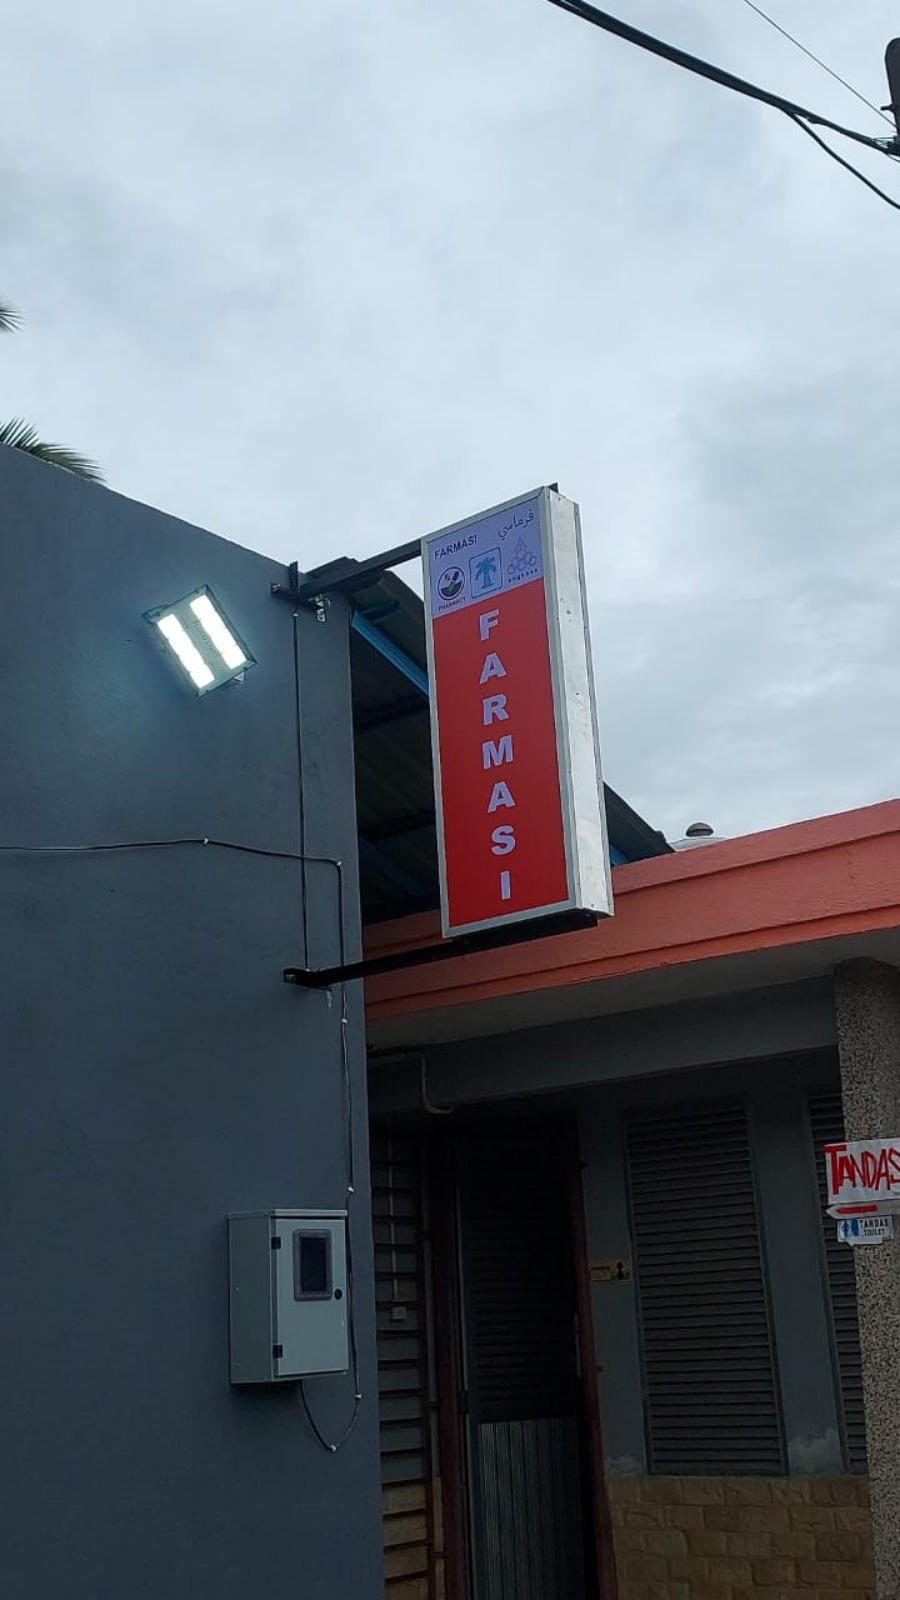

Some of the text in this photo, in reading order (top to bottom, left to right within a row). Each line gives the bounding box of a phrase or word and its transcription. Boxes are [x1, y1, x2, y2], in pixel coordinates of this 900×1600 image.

[499, 508, 535, 541] فرماسي
[434, 534, 477, 560] FARMASI
[479, 609, 516, 901] FARMASI
[822, 1144, 900, 1195] TANDAS
